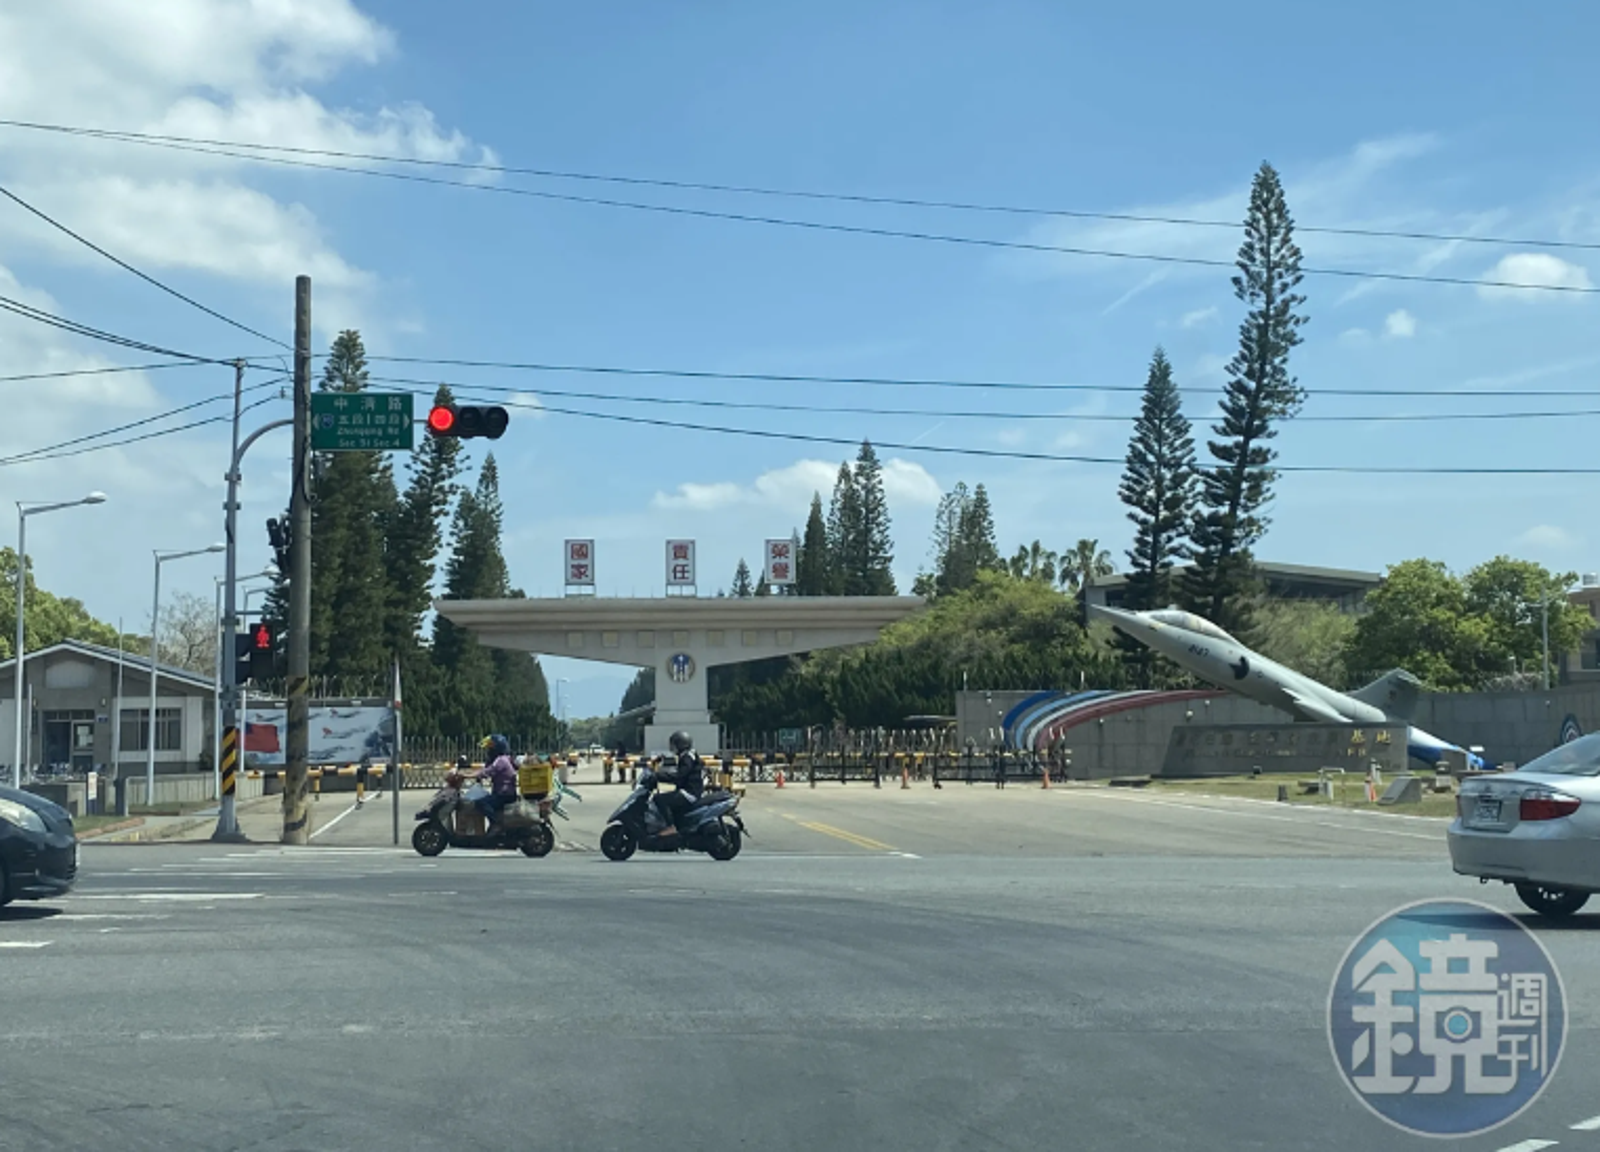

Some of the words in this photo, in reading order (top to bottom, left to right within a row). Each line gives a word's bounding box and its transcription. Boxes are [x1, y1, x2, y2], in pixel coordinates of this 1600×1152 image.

[570, 543, 589, 580] 國家
[671, 544, 690, 581] 責任
[770, 542, 790, 580] 榮譽
